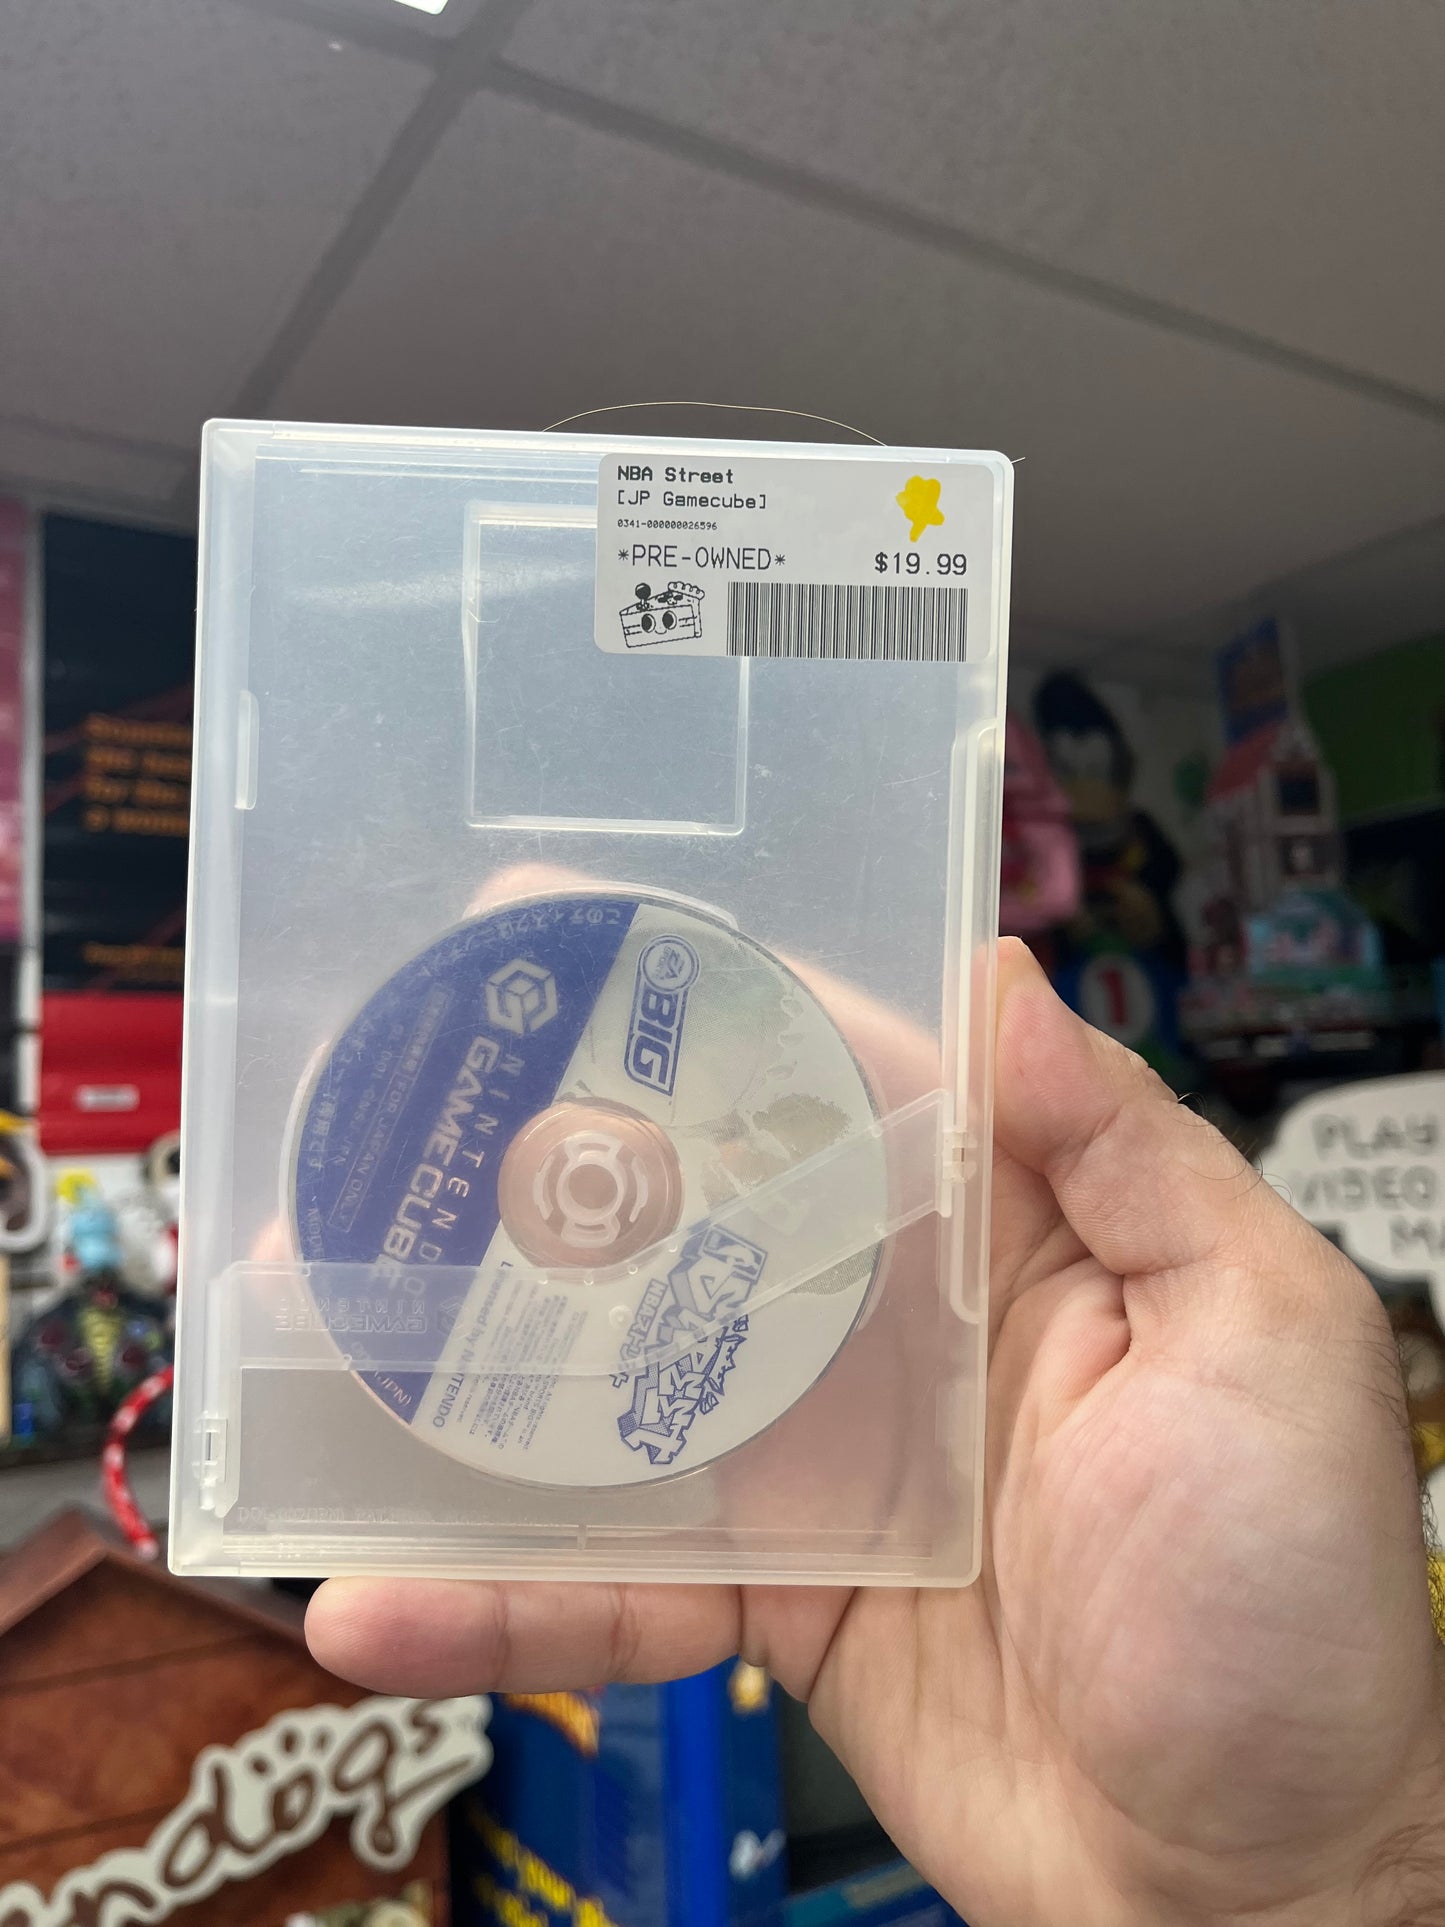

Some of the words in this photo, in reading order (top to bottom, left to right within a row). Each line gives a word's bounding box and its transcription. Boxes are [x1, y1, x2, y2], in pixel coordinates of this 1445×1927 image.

[618, 466, 653, 482] NBA
[665, 467, 734, 484] Street
[617, 490, 651, 507] [JP
[663, 491, 767, 510] Gamecube]
[617, 519, 718, 531] 0341-000000026596
[874, 552, 968, 576] $19.99
[633, 984, 680, 1085] BIG
[366, 1031, 500, 1294] GAMECUBE
[400, 1050, 524, 1300] NINTENDO
